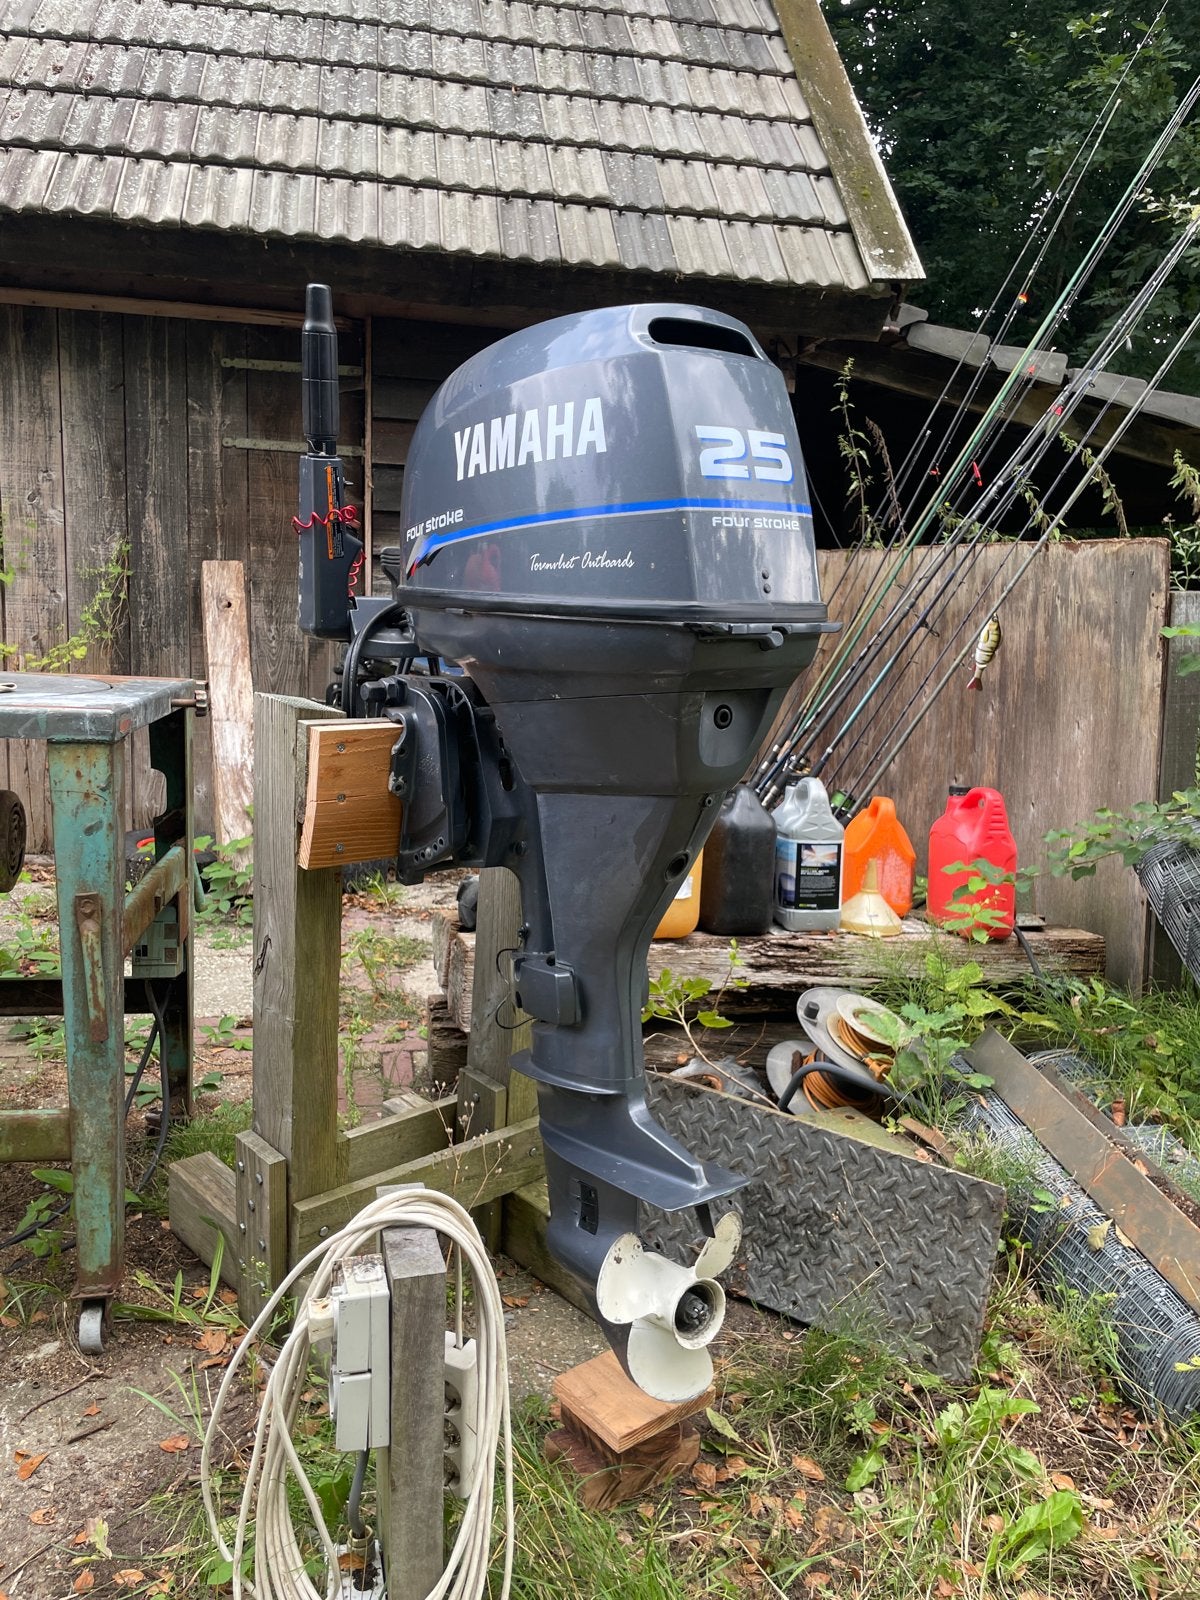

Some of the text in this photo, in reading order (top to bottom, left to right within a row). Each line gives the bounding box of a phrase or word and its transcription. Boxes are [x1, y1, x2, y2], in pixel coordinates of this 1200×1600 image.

[454, 397, 607, 482] YAMAHA
[695, 425, 795, 485] 25
[581, 550, 635, 569] Outboards
